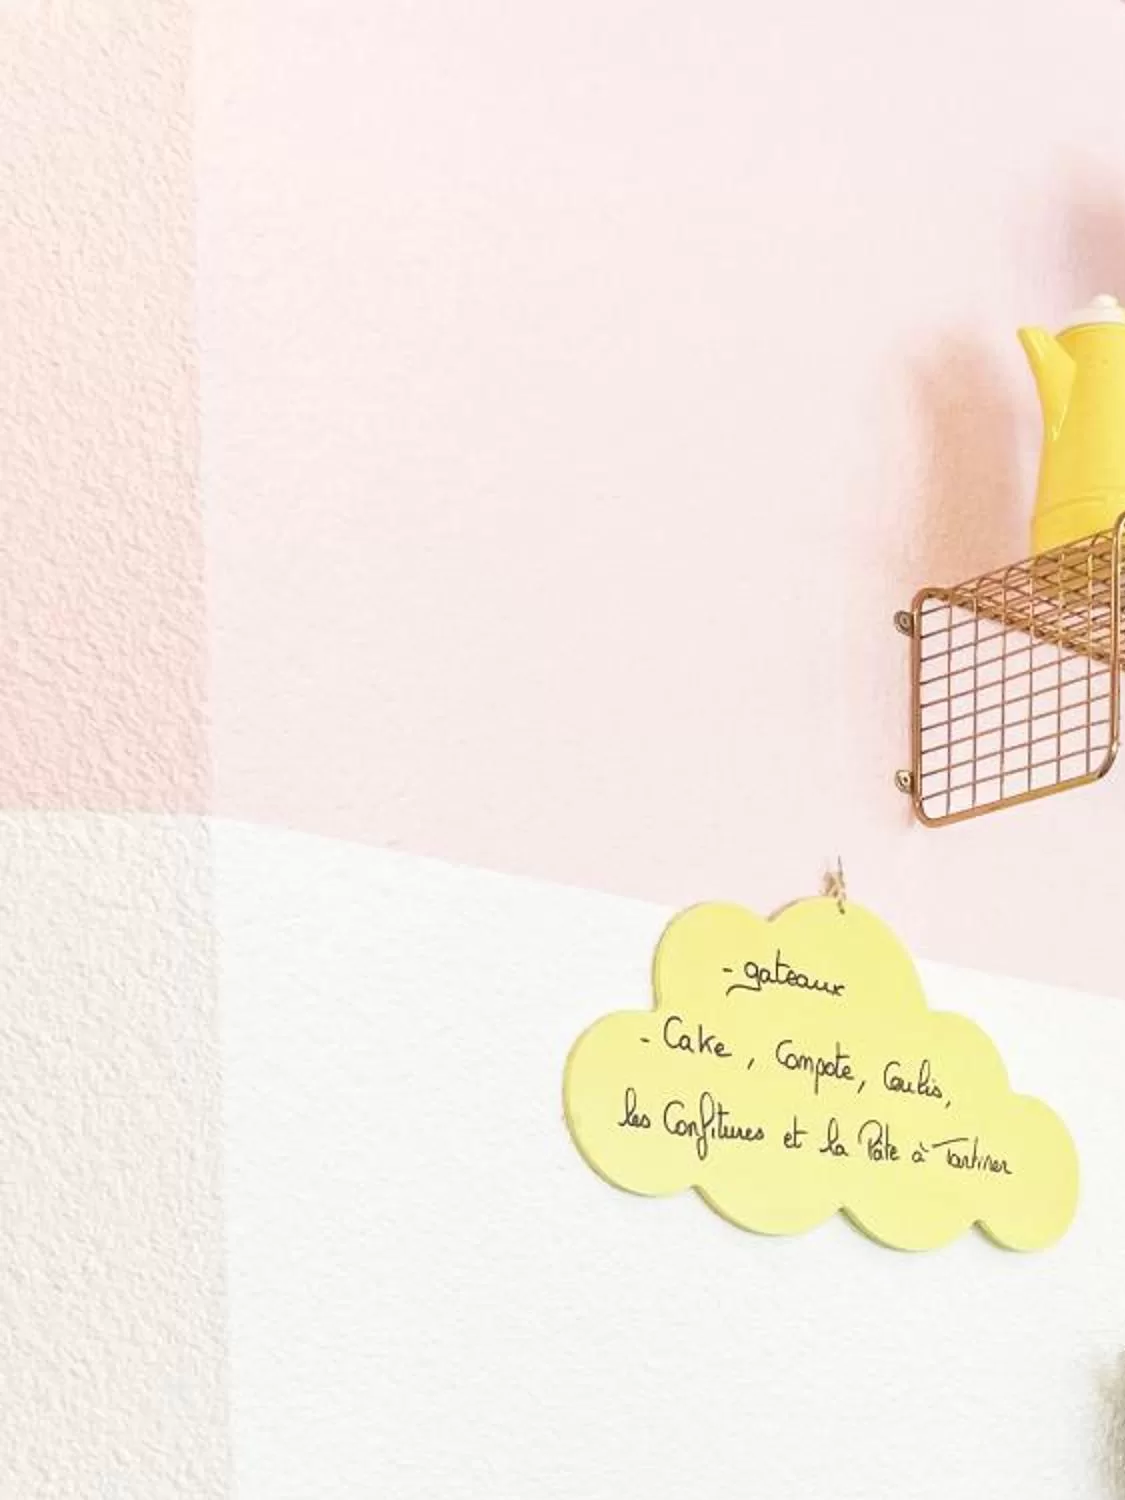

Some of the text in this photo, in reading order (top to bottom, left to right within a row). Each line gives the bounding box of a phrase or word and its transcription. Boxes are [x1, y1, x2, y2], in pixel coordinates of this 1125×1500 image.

[662, 1091, 765, 1161] Confitures
[783, 1115, 808, 1150] et
[819, 1117, 849, 1157] la
